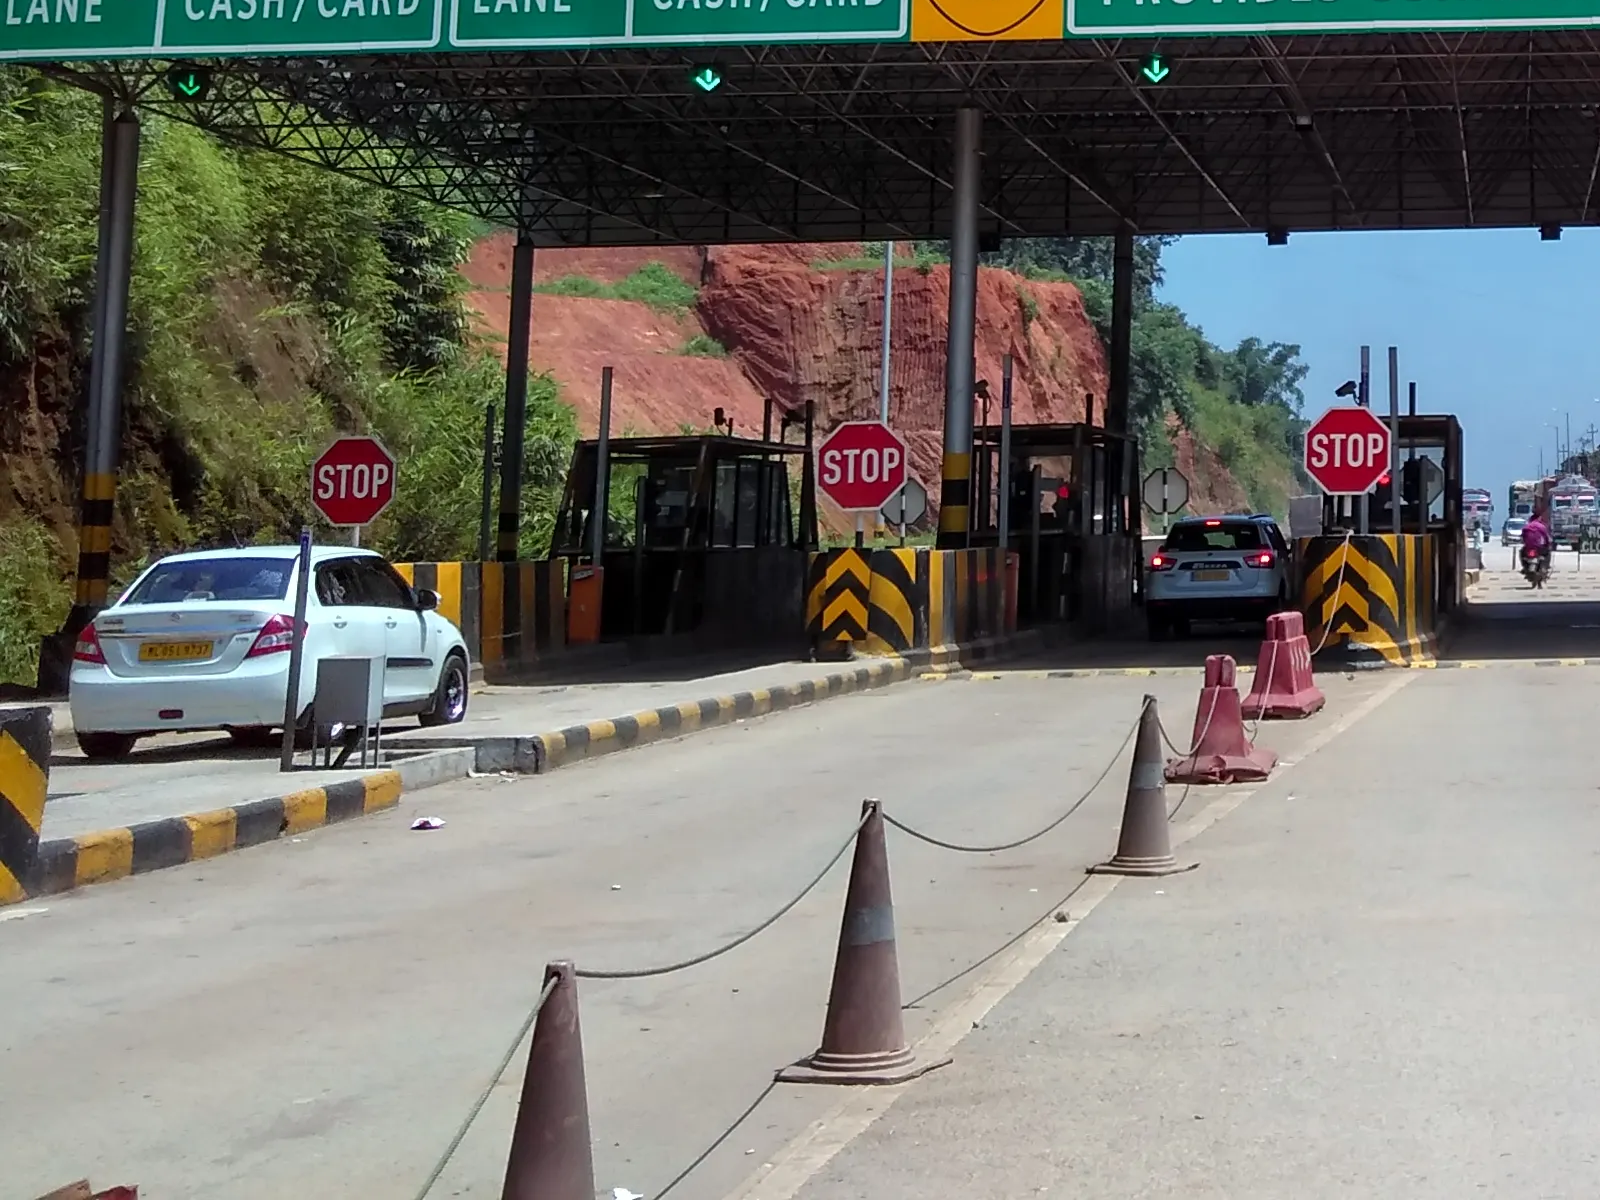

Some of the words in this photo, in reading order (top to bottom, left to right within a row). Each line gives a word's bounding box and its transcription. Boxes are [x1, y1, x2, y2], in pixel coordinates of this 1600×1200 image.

[823, 447, 900, 485] STOP
[1311, 433, 1384, 468] STOP
[317, 464, 389, 499] STOP
